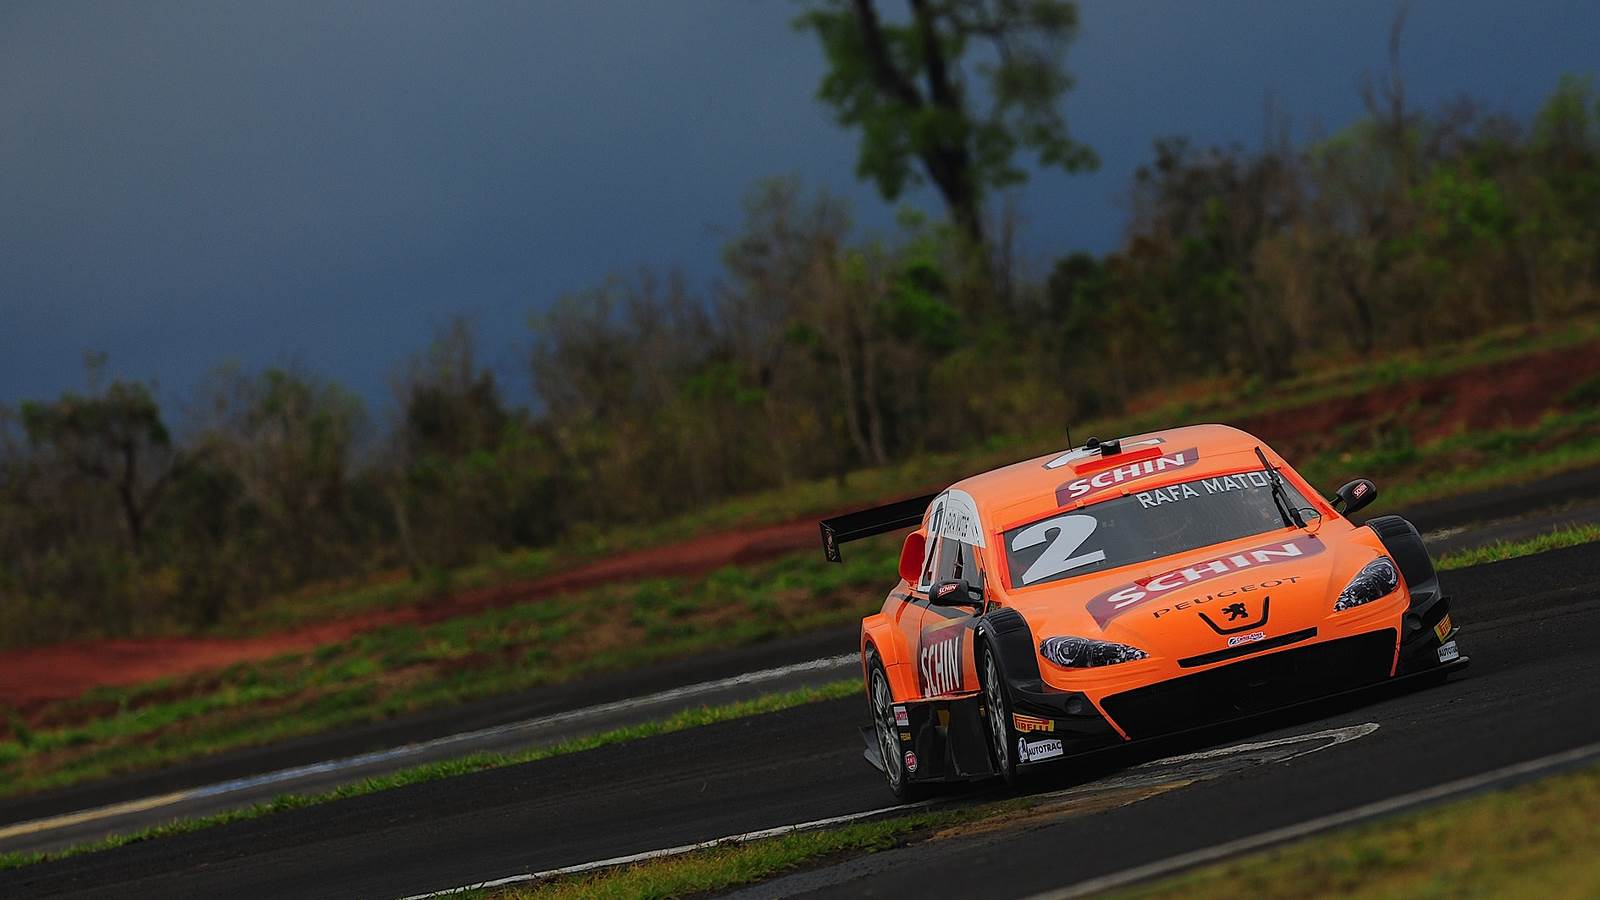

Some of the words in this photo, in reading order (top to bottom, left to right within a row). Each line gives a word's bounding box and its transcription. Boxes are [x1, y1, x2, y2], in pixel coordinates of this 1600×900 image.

[1068, 453, 1185, 498] SCHIN
[1135, 483, 1200, 509] RAFA
[1011, 514, 1107, 585] 2
[938, 583, 957, 595] SCHIN
[1106, 543, 1304, 609] SCHIN
[1152, 576, 1303, 619] PEUGEOT
[921, 635, 960, 698] SCHIN
[1028, 741, 1062, 756] AUTOTRAC
